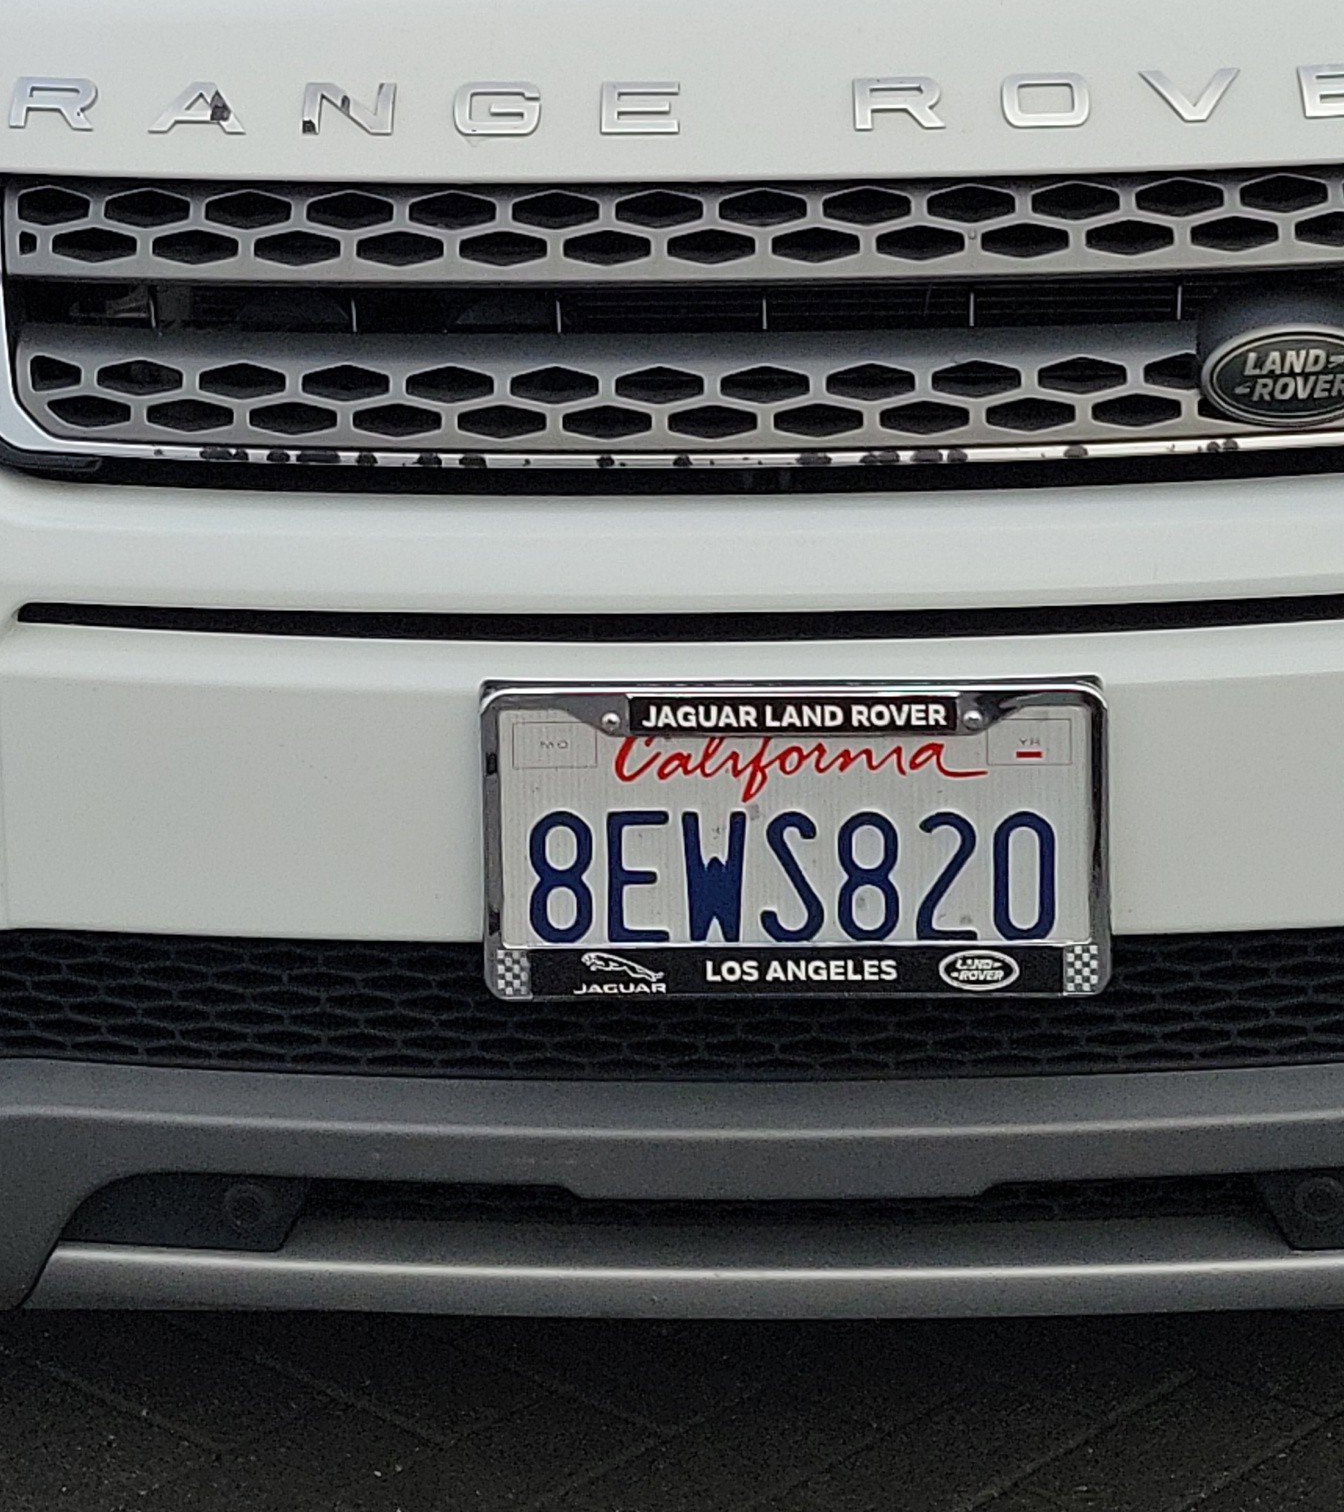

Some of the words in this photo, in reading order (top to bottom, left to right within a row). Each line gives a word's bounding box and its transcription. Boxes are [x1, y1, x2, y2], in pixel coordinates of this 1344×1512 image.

[8, 76, 681, 135] RANGE
[1244, 349, 1327, 375] LAND
[642, 705, 757, 728] JAGUAR
[765, 704, 843, 727] LAND
[851, 703, 947, 727] ROVER
[613, 737, 988, 803] California
[529, 811, 1056, 942] 8EWS820
[706, 960, 759, 981] LOS
[765, 960, 898, 981] ANGELES
[956, 958, 994, 969] LAND
[958, 970, 1004, 981] ROVER
[574, 983, 666, 994] JAGUAR
